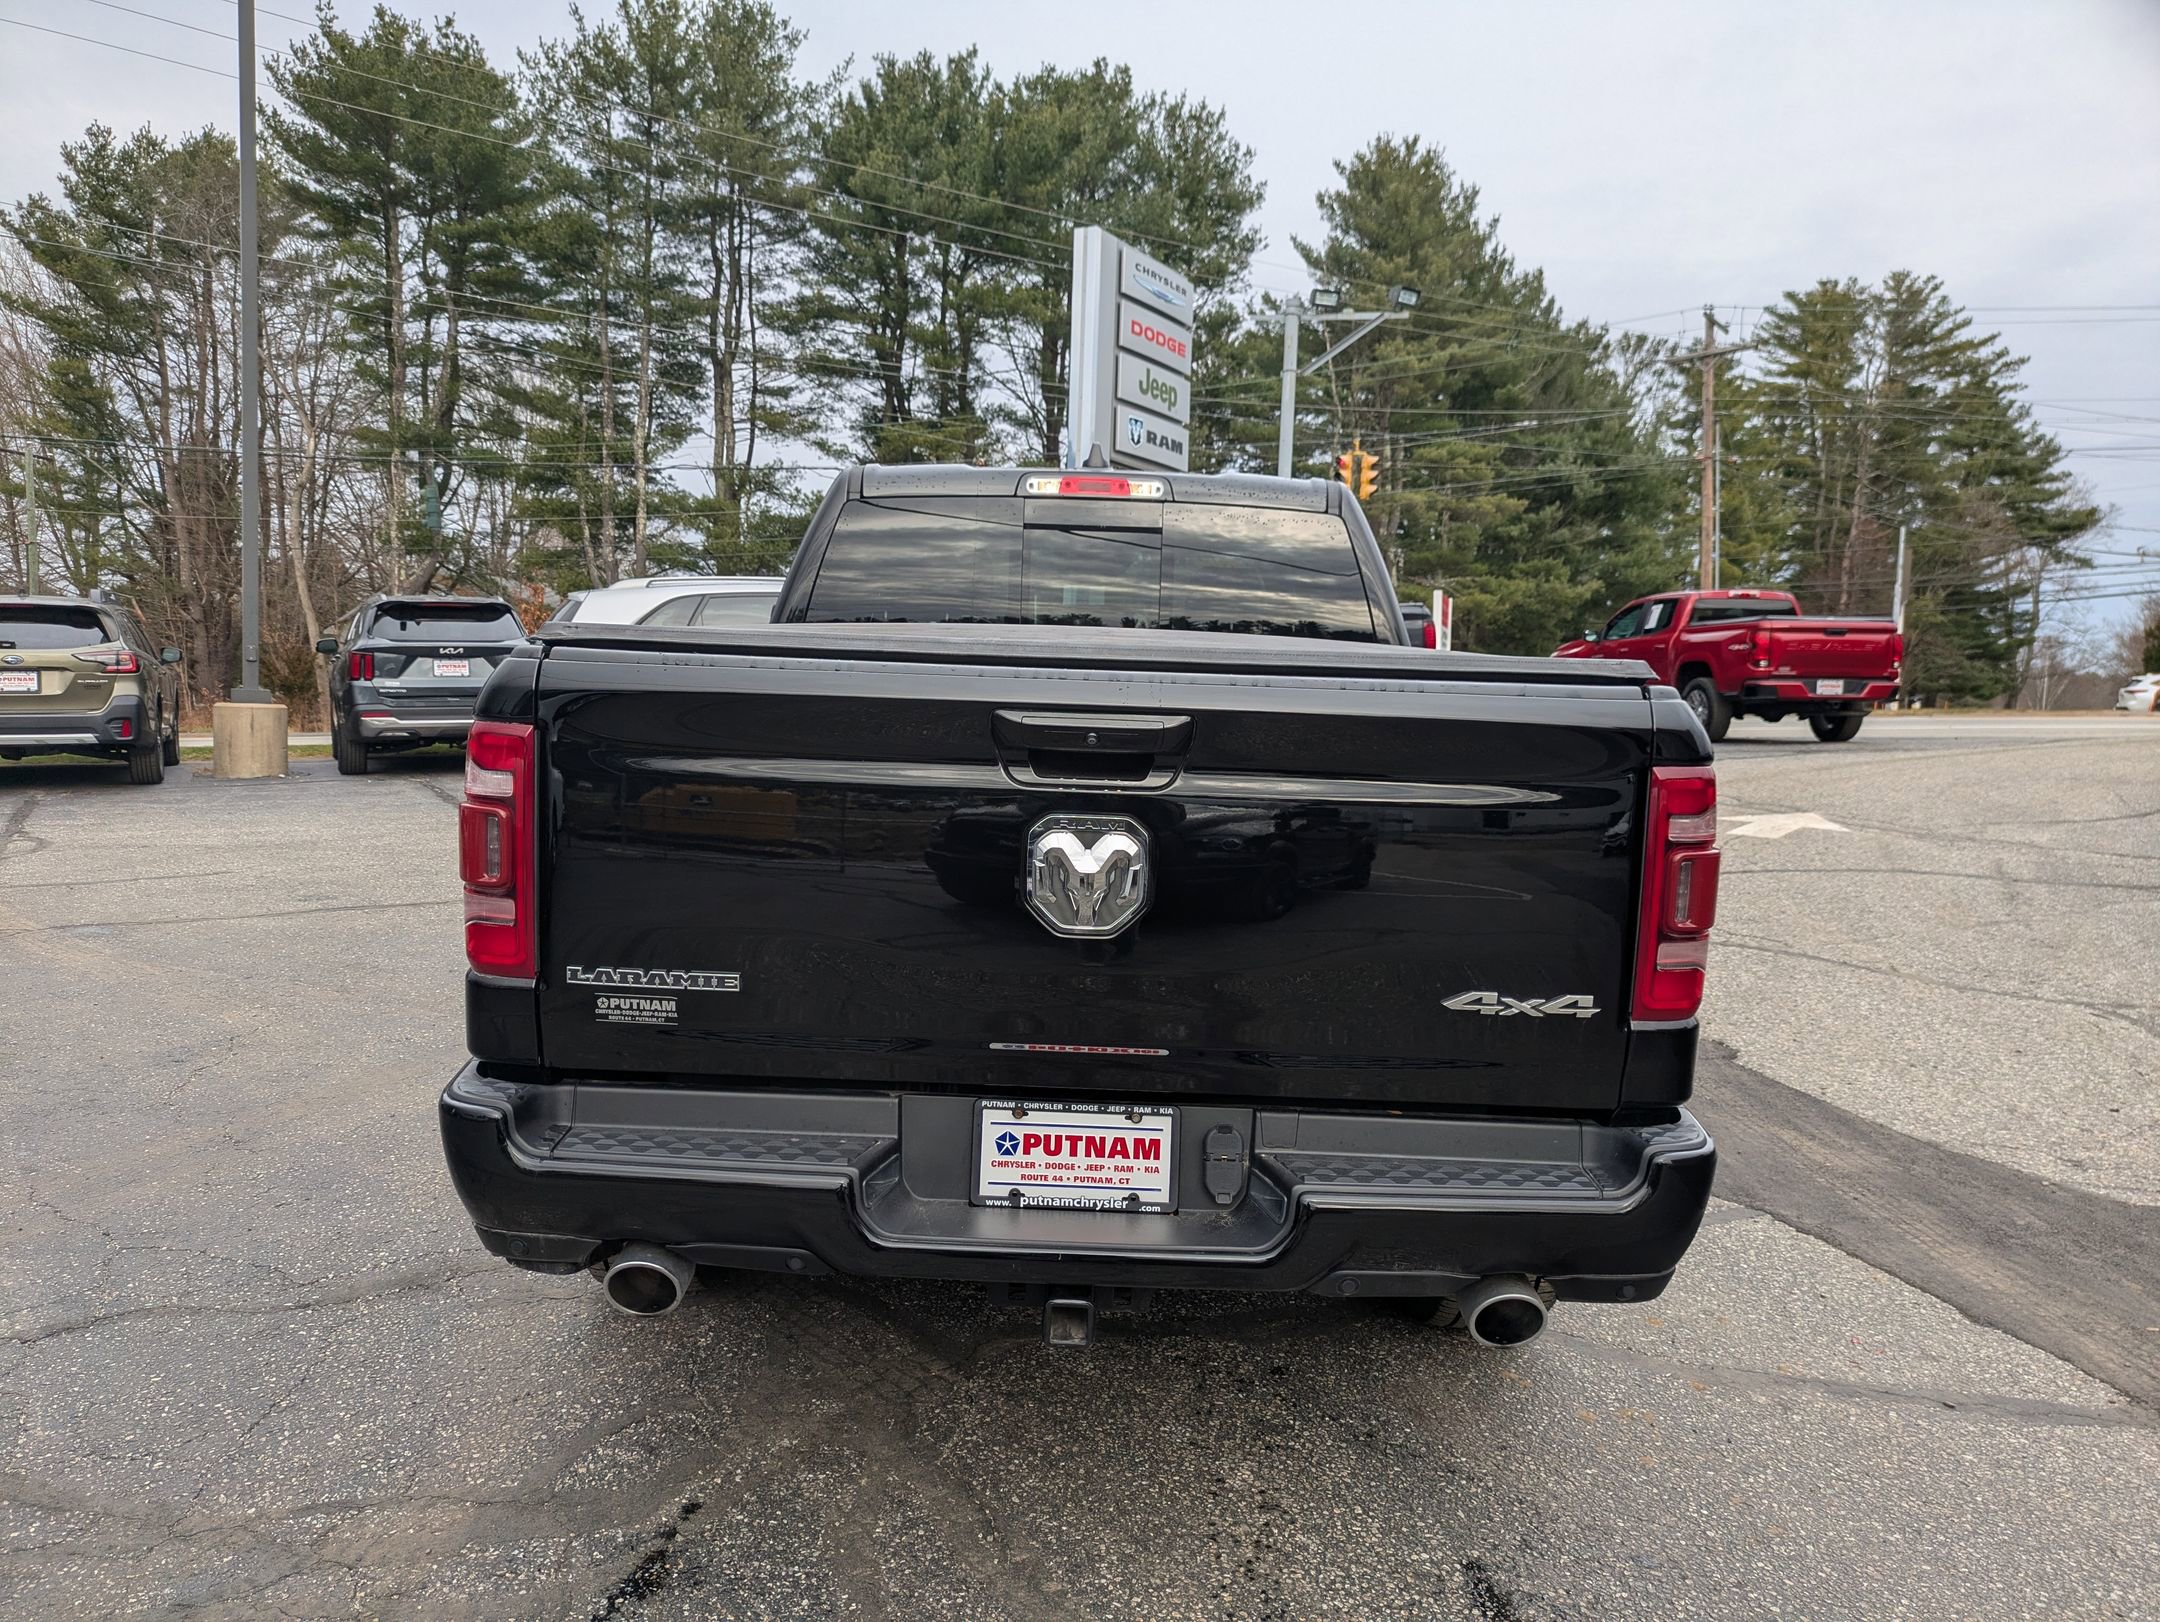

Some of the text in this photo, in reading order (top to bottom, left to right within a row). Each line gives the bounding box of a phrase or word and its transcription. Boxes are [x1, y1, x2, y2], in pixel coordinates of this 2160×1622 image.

[1135, 263, 1187, 297] CHRYSLER
[1131, 320, 1186, 358] DODGE
[1139, 368, 1178, 411] Jeep
[1146, 430, 1183, 455] RAM
[1052, 820, 1126, 831] RAM
[567, 966, 740, 991] LARAMIE
[609, 997, 676, 1011] PUTNAM
[1440, 991, 1602, 1018] 4x4
[981, 1100, 1016, 1108] PUTNAM
[1023, 1102, 1063, 1110] CHRYSLER
[1106, 1105, 1126, 1113] JEEP
[1159, 1107, 1174, 1115] KIA
[1022, 1133, 1161, 1160] PUTNAM
[990, 1160, 1160, 1174] CHRYSLER DODGE JEEP RAM KIA
[1020, 1173, 1131, 1185] ROUTE 44 PUTNAM, CT
